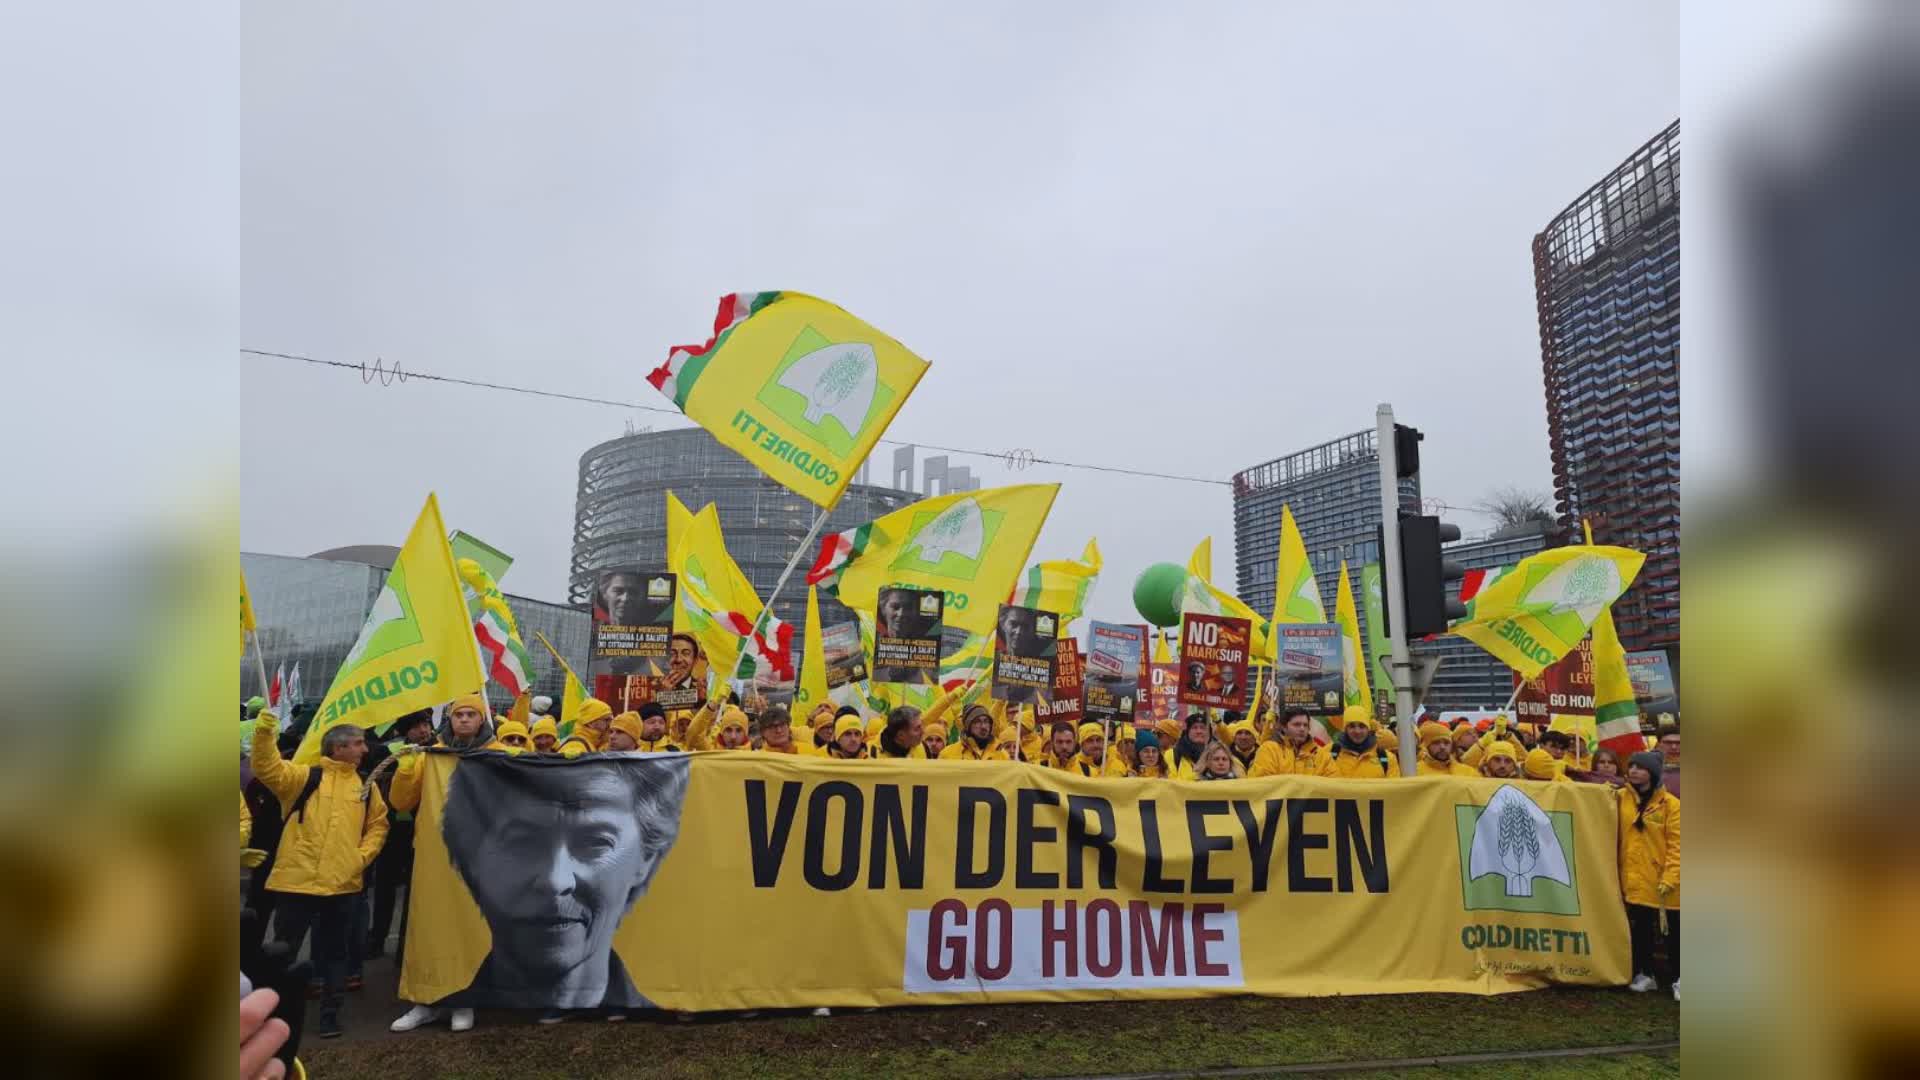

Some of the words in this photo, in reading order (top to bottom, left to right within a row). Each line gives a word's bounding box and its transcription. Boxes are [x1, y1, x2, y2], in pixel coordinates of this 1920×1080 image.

[1188, 620, 1218, 647] NO
[1186, 645, 1243, 664] MARKSUR
[1053, 676, 1078, 689] EYEN
[619, 686, 647, 700] LYEN
[1550, 694, 1566, 707] GO
[1052, 698, 1080, 715] HOME
[744, 780, 930, 893] VON
[954, 788, 1118, 890] DER
[1139, 798, 1390, 894] LEYEN
[926, 898, 1013, 981] GO
[1041, 899, 1230, 977] HOME
[1461, 924, 1591, 956] COLDIRETTI
